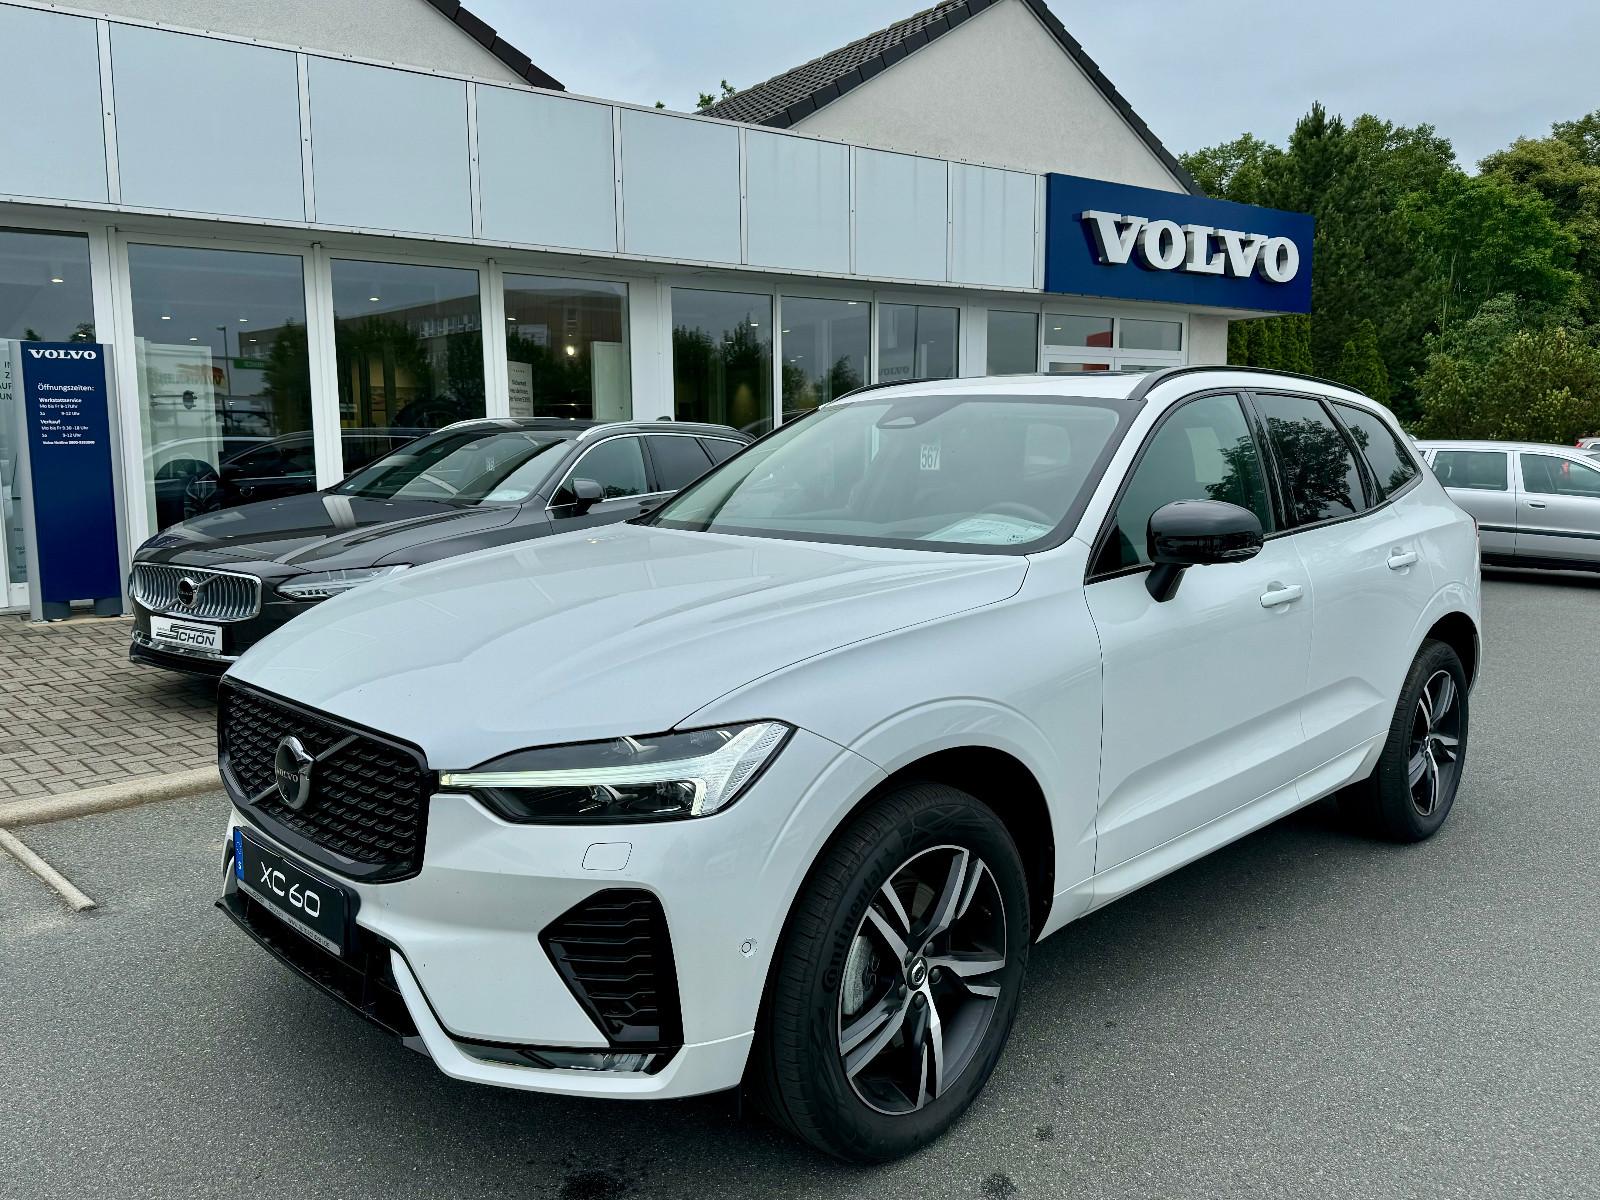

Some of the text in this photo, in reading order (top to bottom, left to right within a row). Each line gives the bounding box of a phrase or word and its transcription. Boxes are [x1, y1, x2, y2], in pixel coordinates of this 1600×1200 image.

[1082, 210, 1300, 283] VOLVO
[28, 349, 96, 360] VOLVO
[38, 382, 95, 392] Öffnungszeiten:
[921, 446, 939, 469] 567
